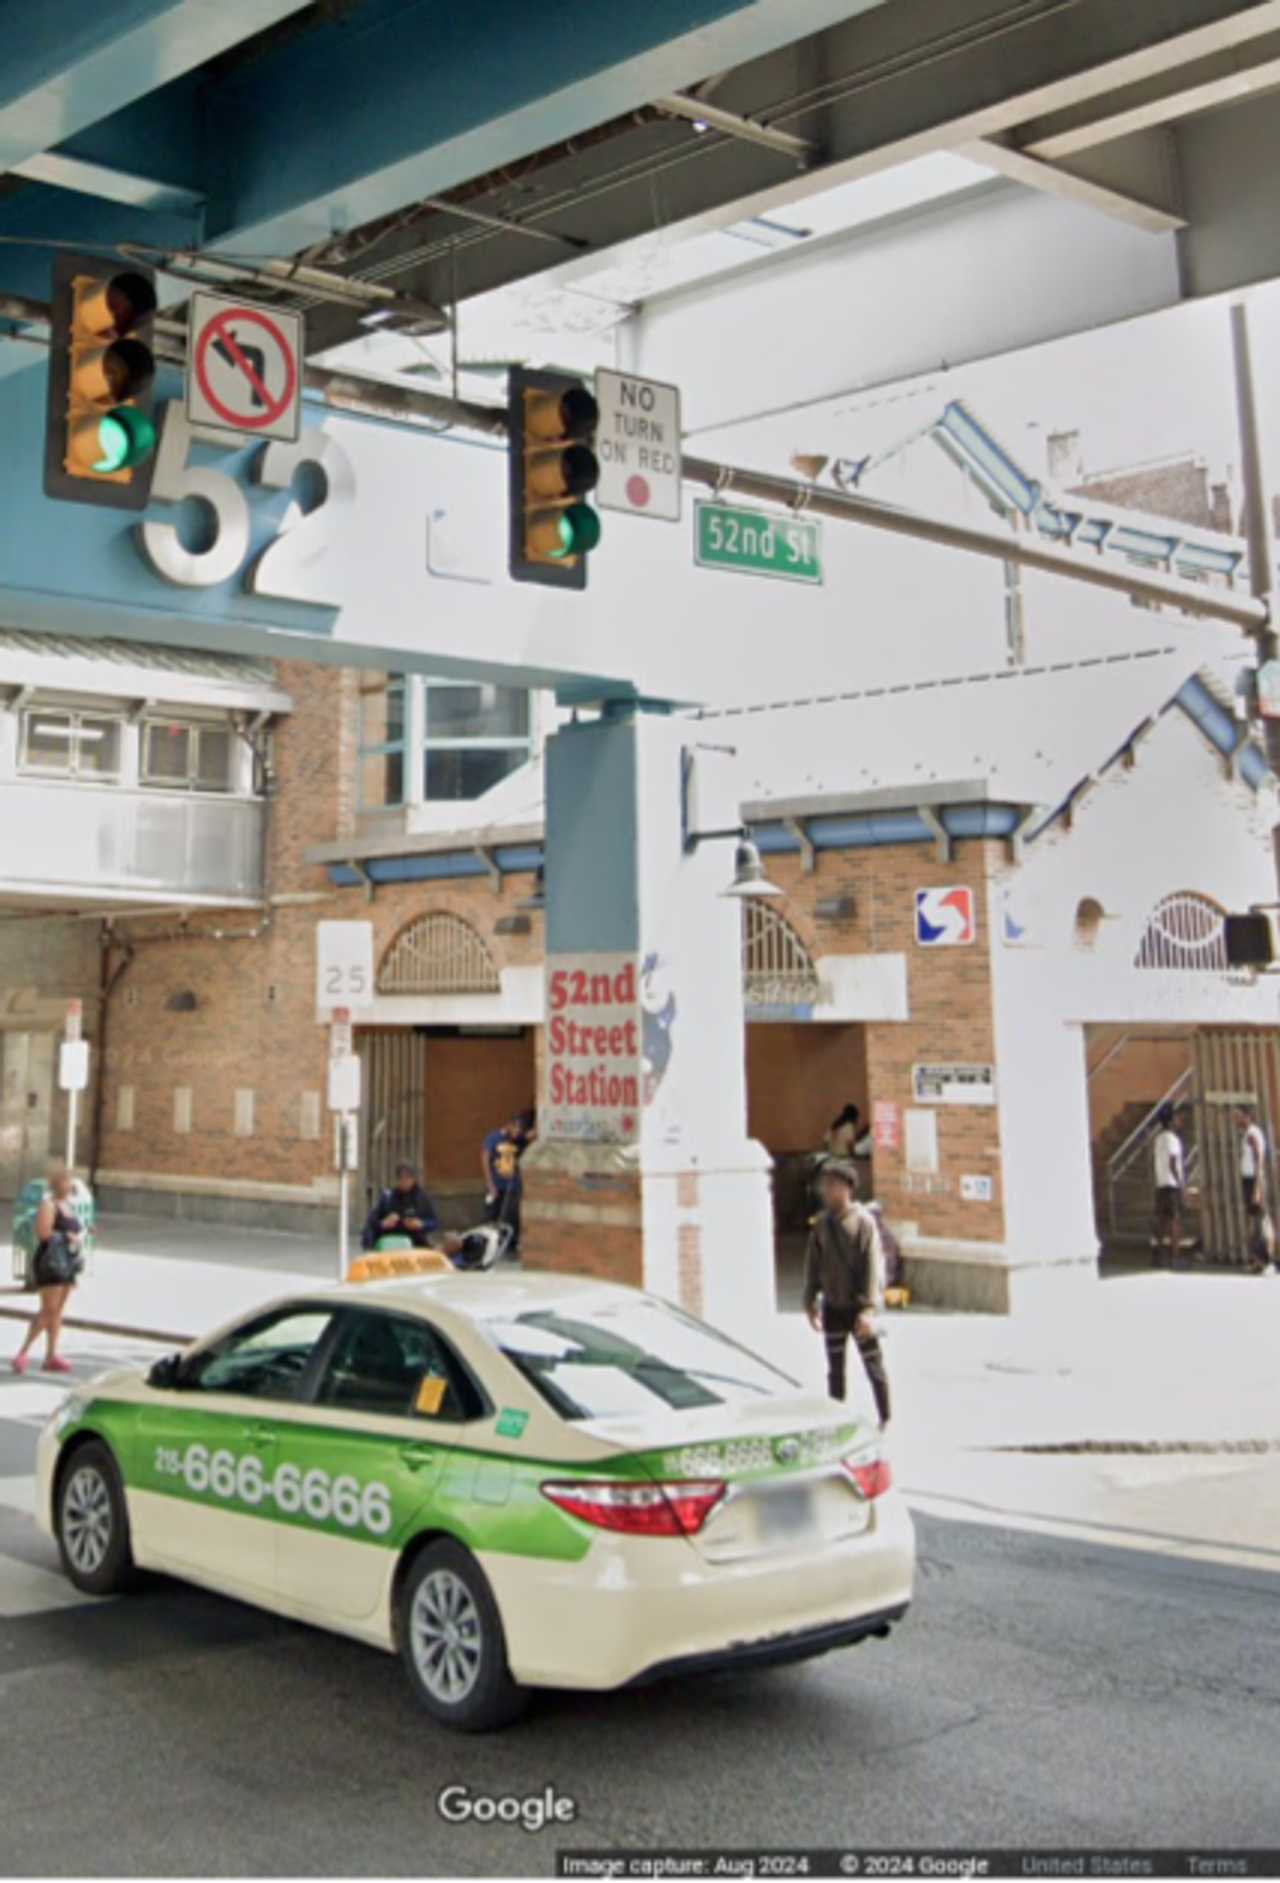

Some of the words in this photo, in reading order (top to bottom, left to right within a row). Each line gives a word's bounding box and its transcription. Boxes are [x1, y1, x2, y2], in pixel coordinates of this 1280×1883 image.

[619, 381, 656, 412] NO
[613, 413, 664, 442] TURN
[600, 440, 626, 464] ON
[638, 446, 674, 475] RED
[136, 398, 356, 602] 52
[709, 515, 775, 560] 52nd
[786, 526, 812, 565] St
[326, 965, 365, 994] 25
[551, 962, 636, 1010] 52nd
[551, 1015, 637, 1057] Street
[551, 1062, 639, 1107] Station
